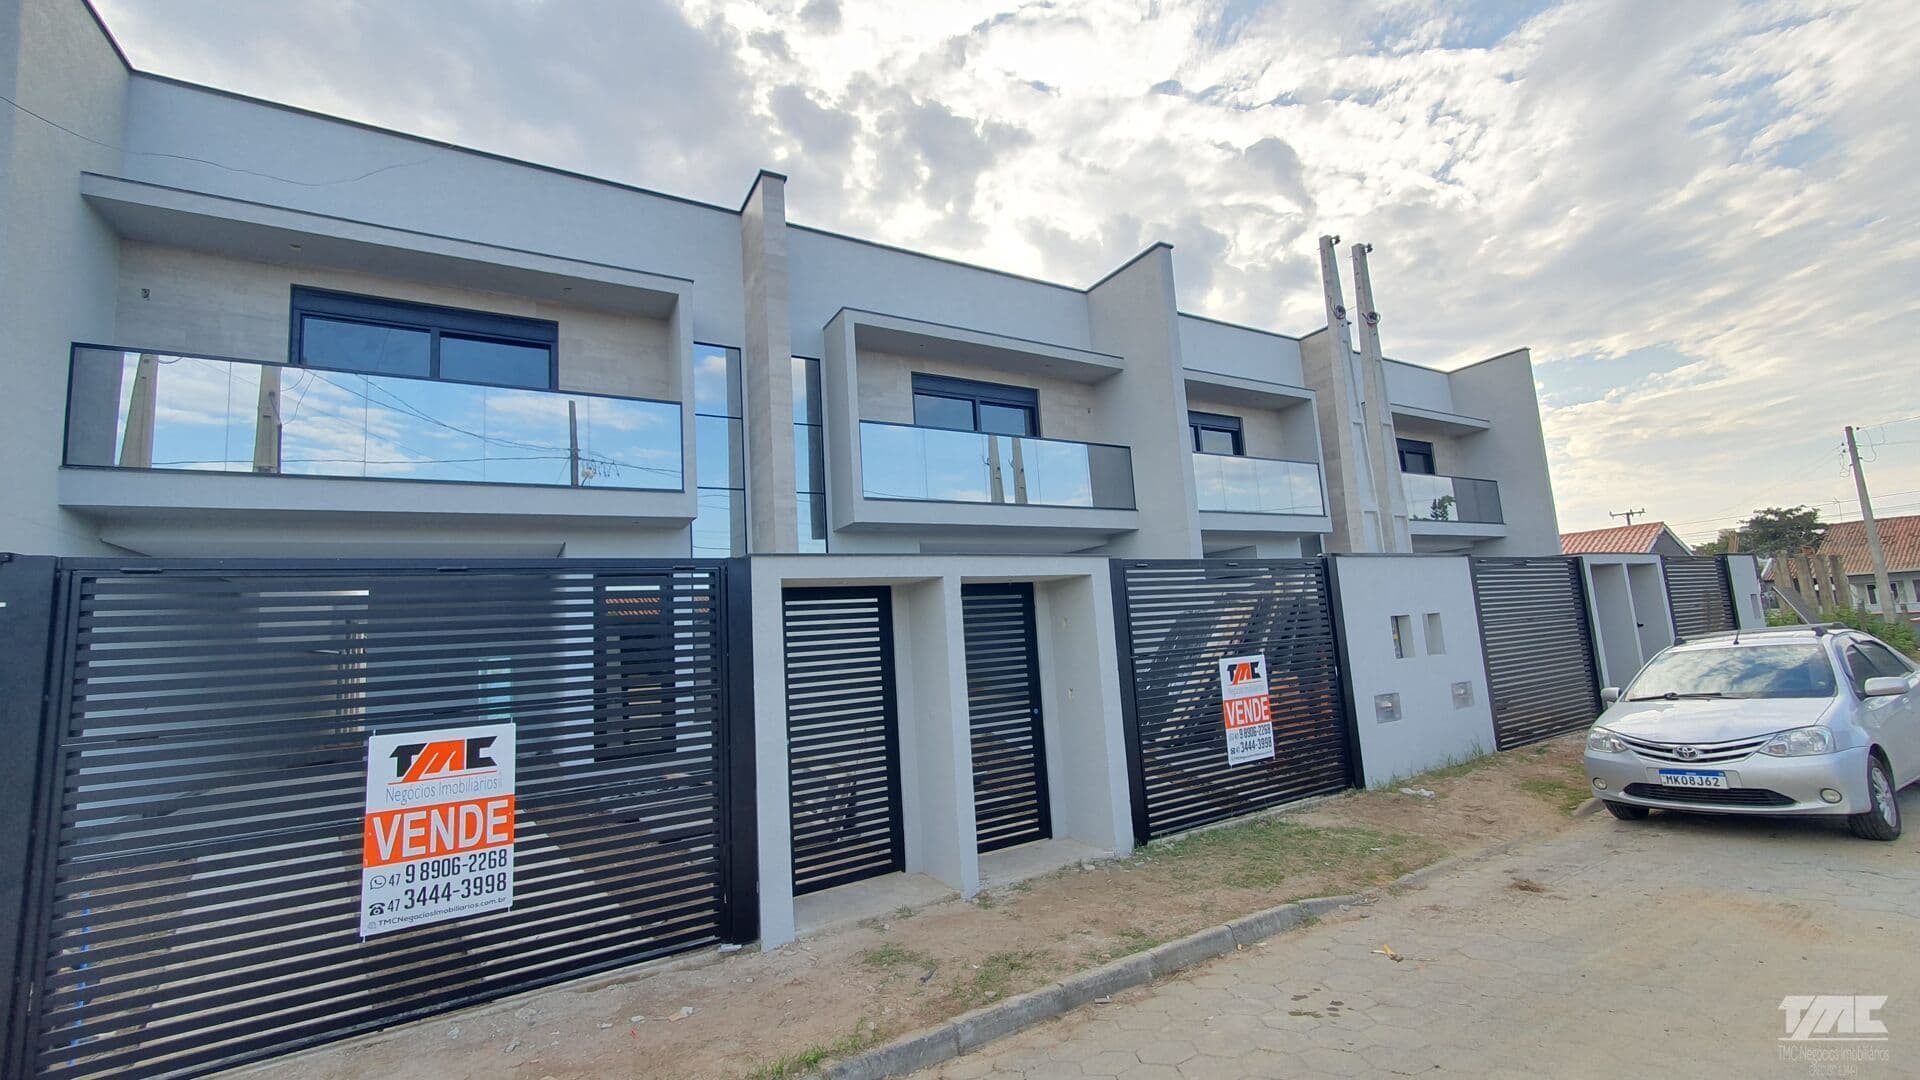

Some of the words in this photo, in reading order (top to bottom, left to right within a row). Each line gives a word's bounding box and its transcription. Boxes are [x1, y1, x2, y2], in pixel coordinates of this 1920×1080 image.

[1227, 661, 1261, 685] TMC
[1225, 697, 1270, 726] VENDE
[389, 736, 498, 783] TMC
[385, 783, 436, 806] Negócios
[438, 777, 498, 796] Imobiliários
[373, 799, 509, 861] VENDE
[388, 873, 401, 887] 47
[405, 863, 416, 884] 9
[419, 848, 508, 882] 8906-2268
[387, 898, 400, 913] 47
[403, 872, 507, 910] 3444-3998
